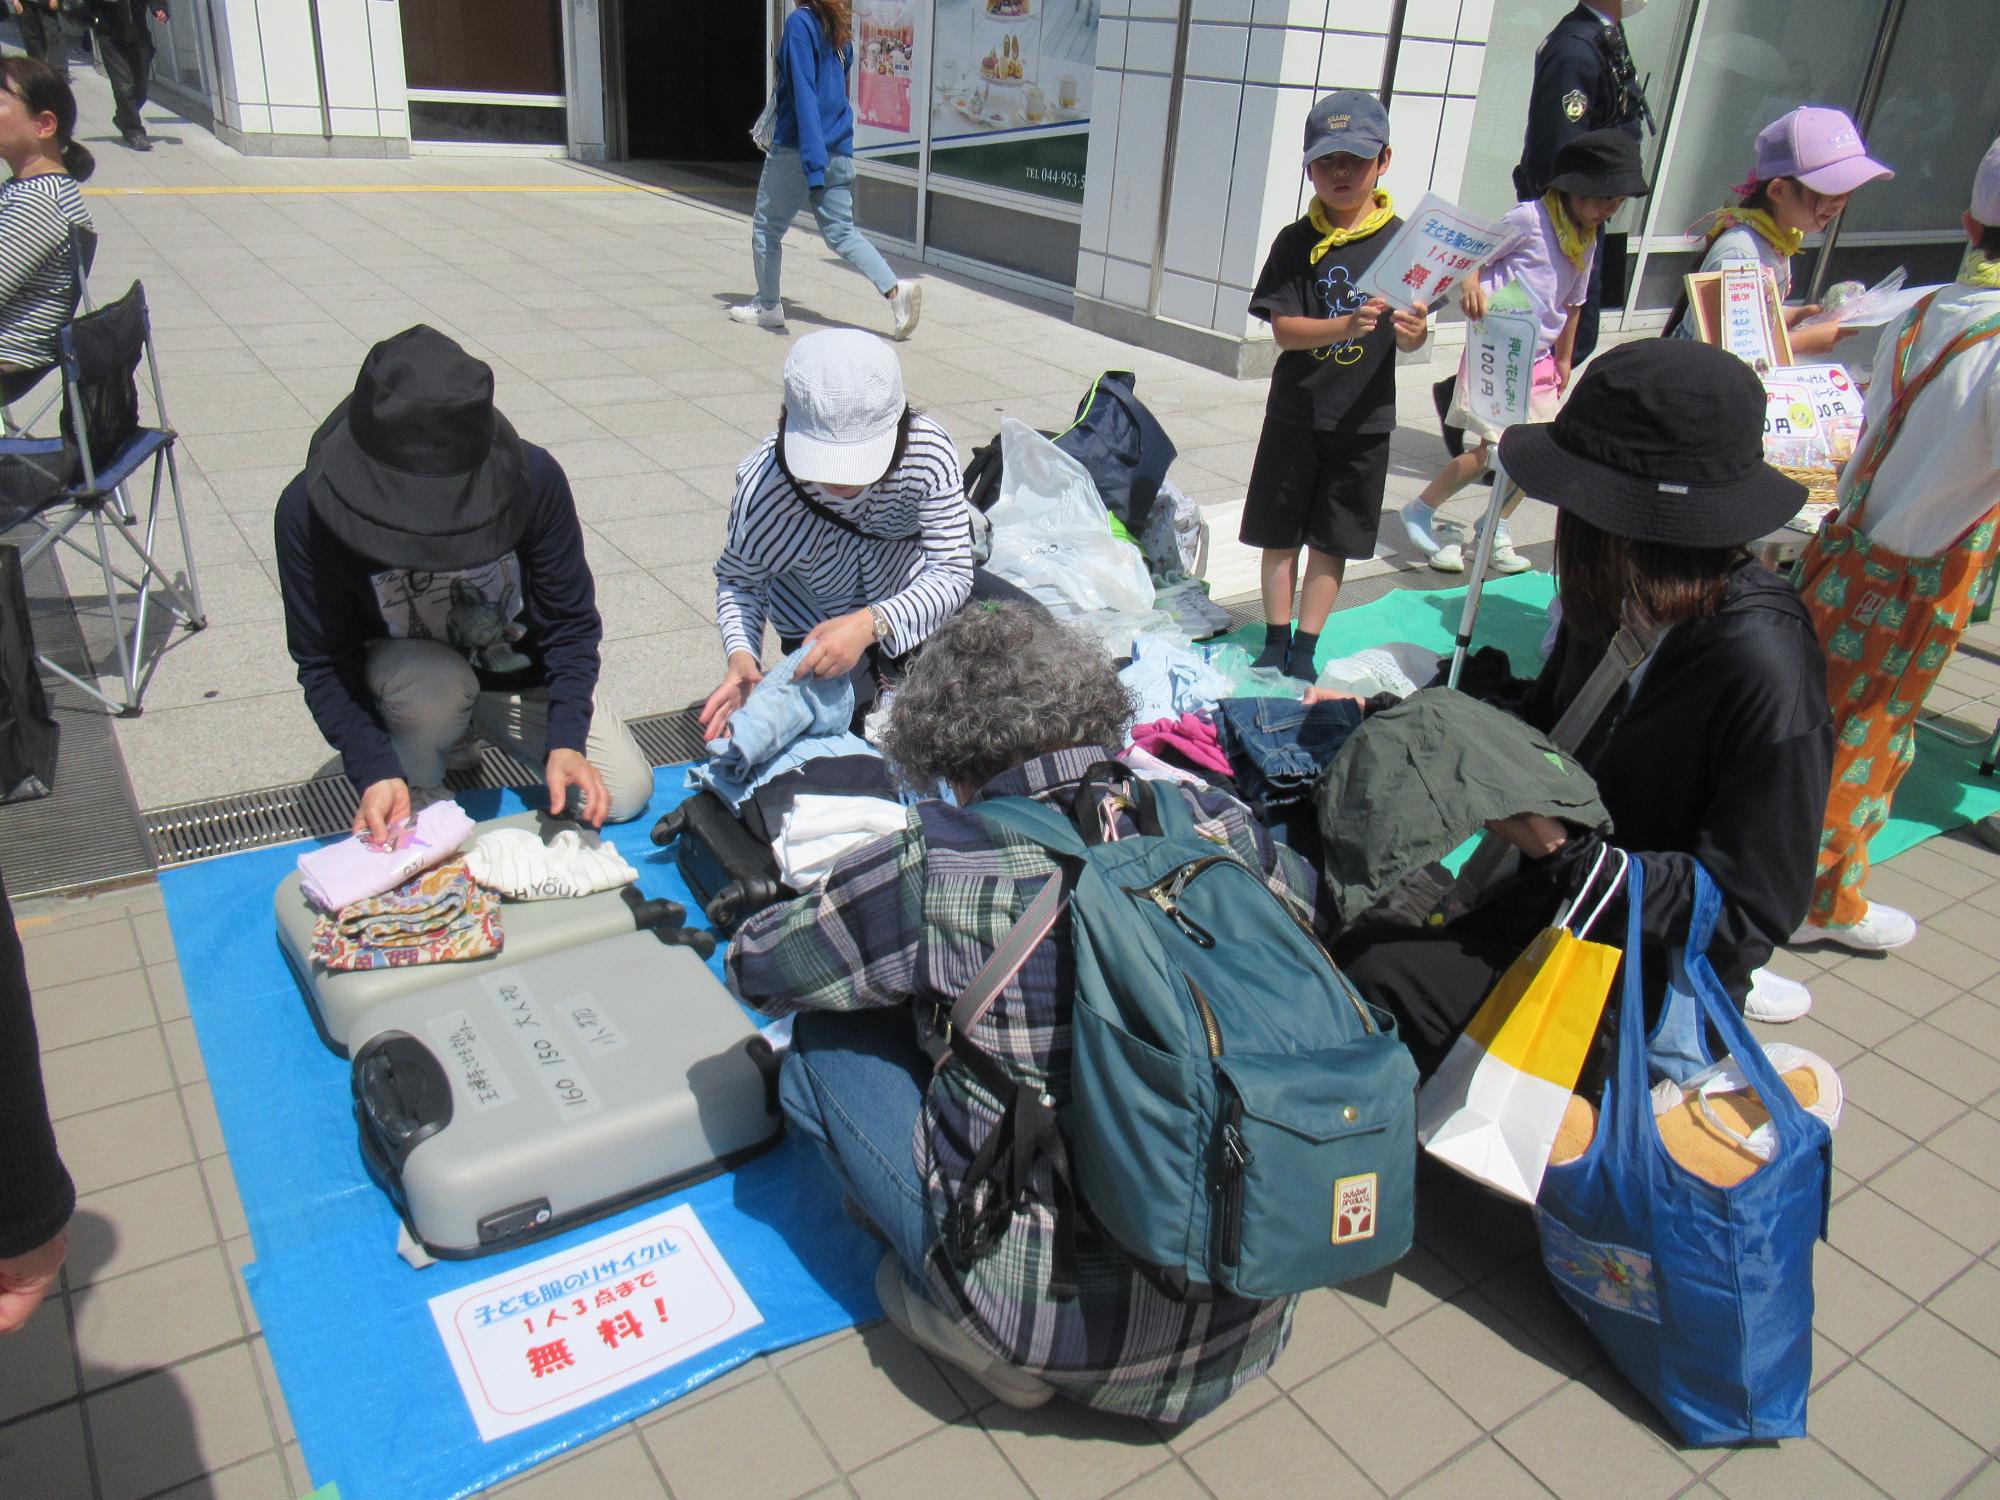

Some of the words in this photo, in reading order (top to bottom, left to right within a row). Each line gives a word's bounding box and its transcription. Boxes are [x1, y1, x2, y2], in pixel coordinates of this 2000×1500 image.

[1025, 166, 1040, 180] TEL
[1481, 343, 1496, 397] 100円
[533, 1039, 565, 1066] 150
[555, 1078, 588, 1106] 160
[474, 1237, 678, 1325] 子ども服のリサイクル
[522, 1270, 658, 1334] 1人3点まで
